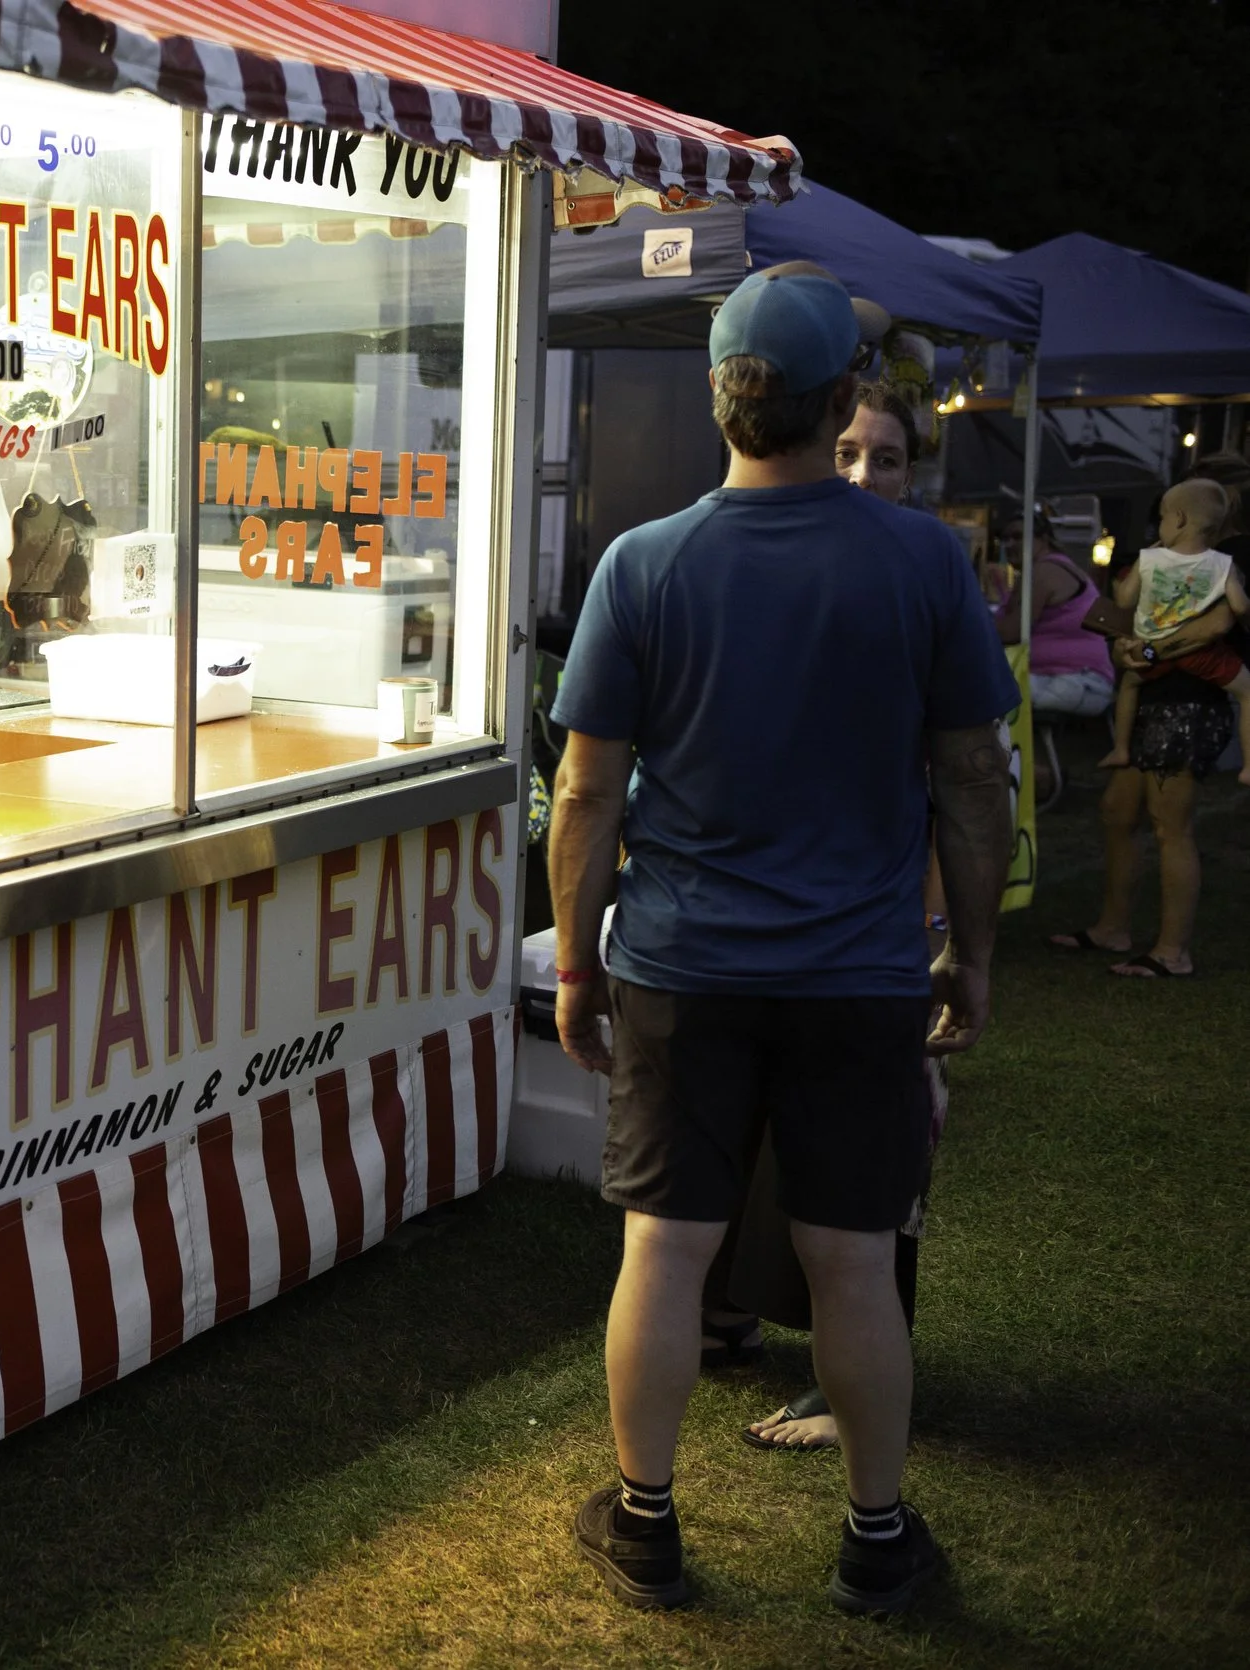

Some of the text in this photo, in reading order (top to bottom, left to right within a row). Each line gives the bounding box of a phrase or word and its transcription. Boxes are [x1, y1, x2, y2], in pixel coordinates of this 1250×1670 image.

[204, 113, 460, 202] THANK YOU
[48, 202, 171, 377] EARS
[314, 806, 505, 1020] EARS
[195, 1070, 222, 1113] &
[237, 1021, 347, 1097] SUGAR
